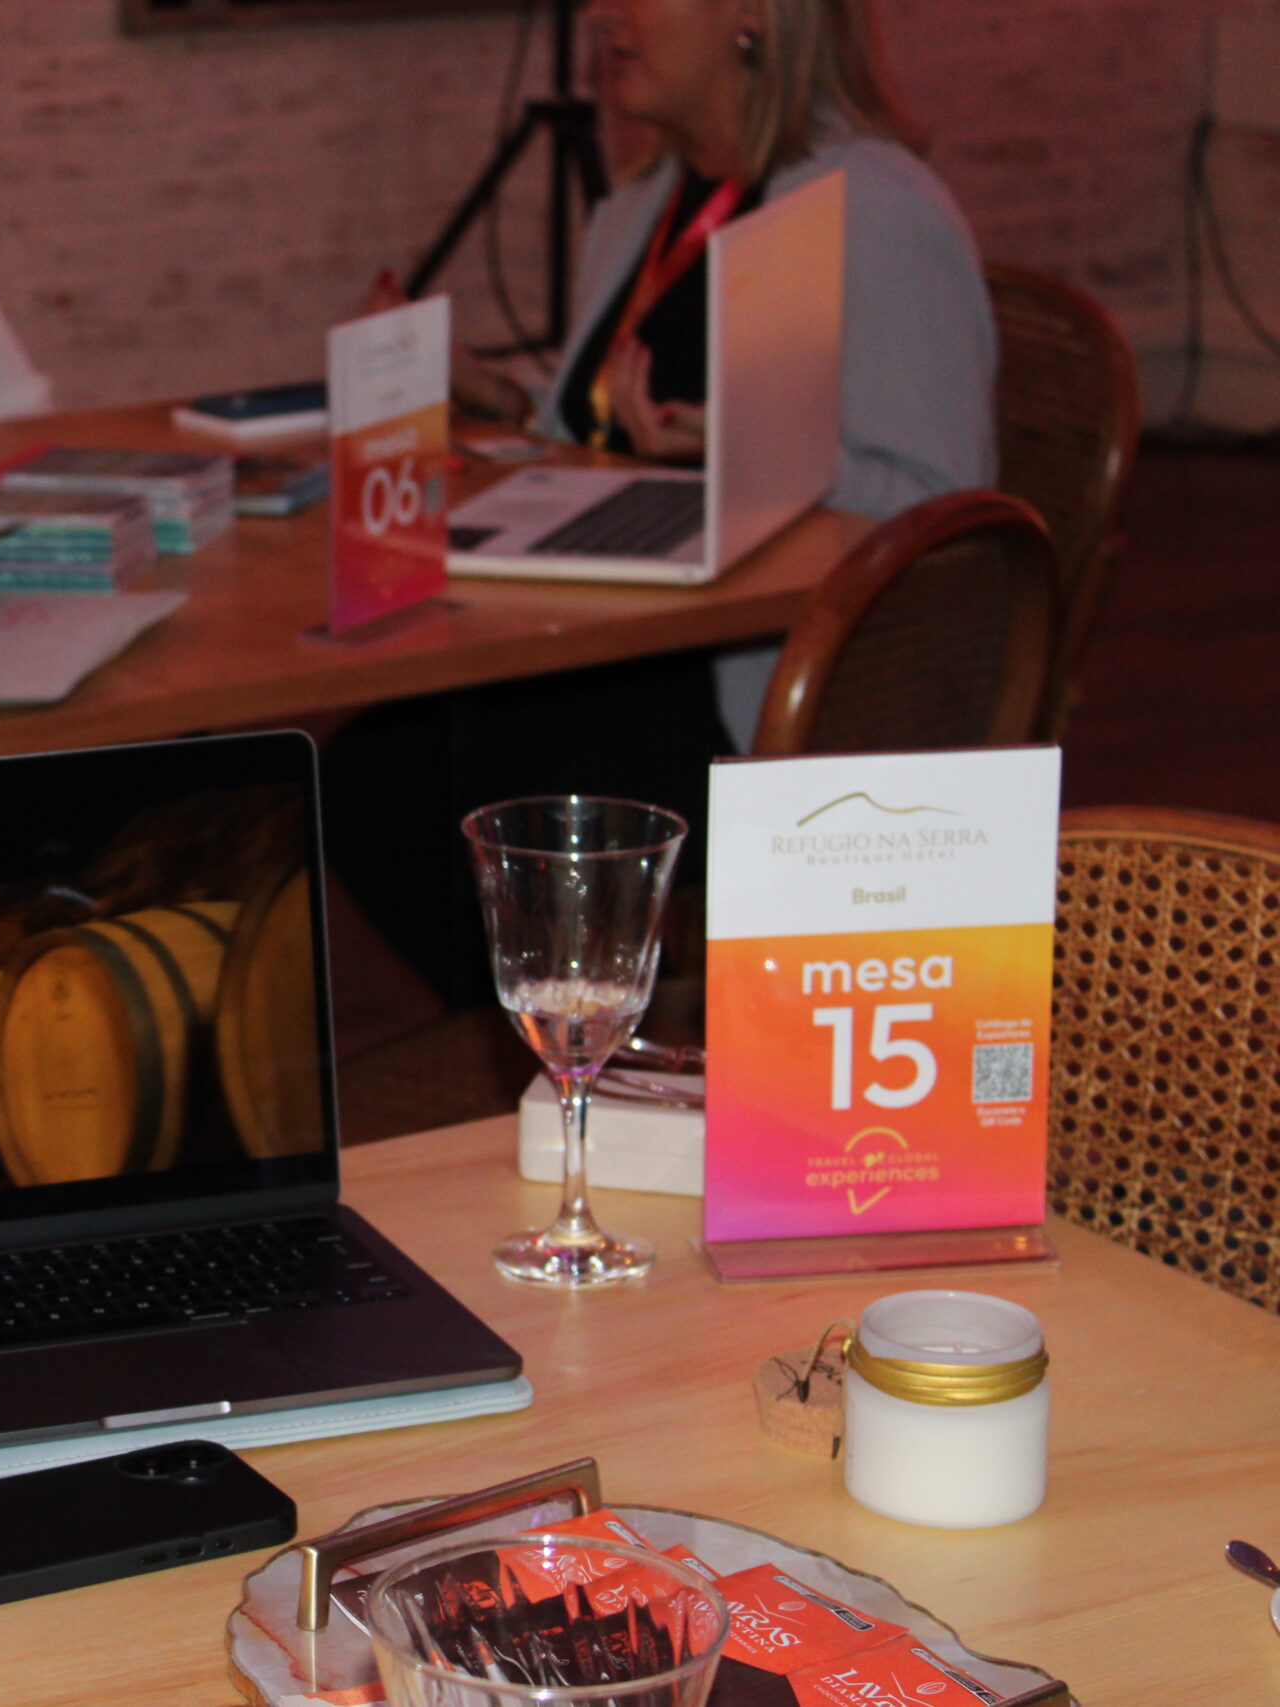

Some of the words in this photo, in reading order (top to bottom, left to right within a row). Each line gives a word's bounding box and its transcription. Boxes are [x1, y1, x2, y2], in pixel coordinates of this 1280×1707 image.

[361, 456, 421, 536] 06
[877, 832, 912, 850] NA
[919, 828, 988, 848] SERRA
[851, 886, 907, 905] Brasil
[801, 955, 953, 994] mesa
[812, 1002, 938, 1111] 15
[805, 1166, 940, 1189] experiences
